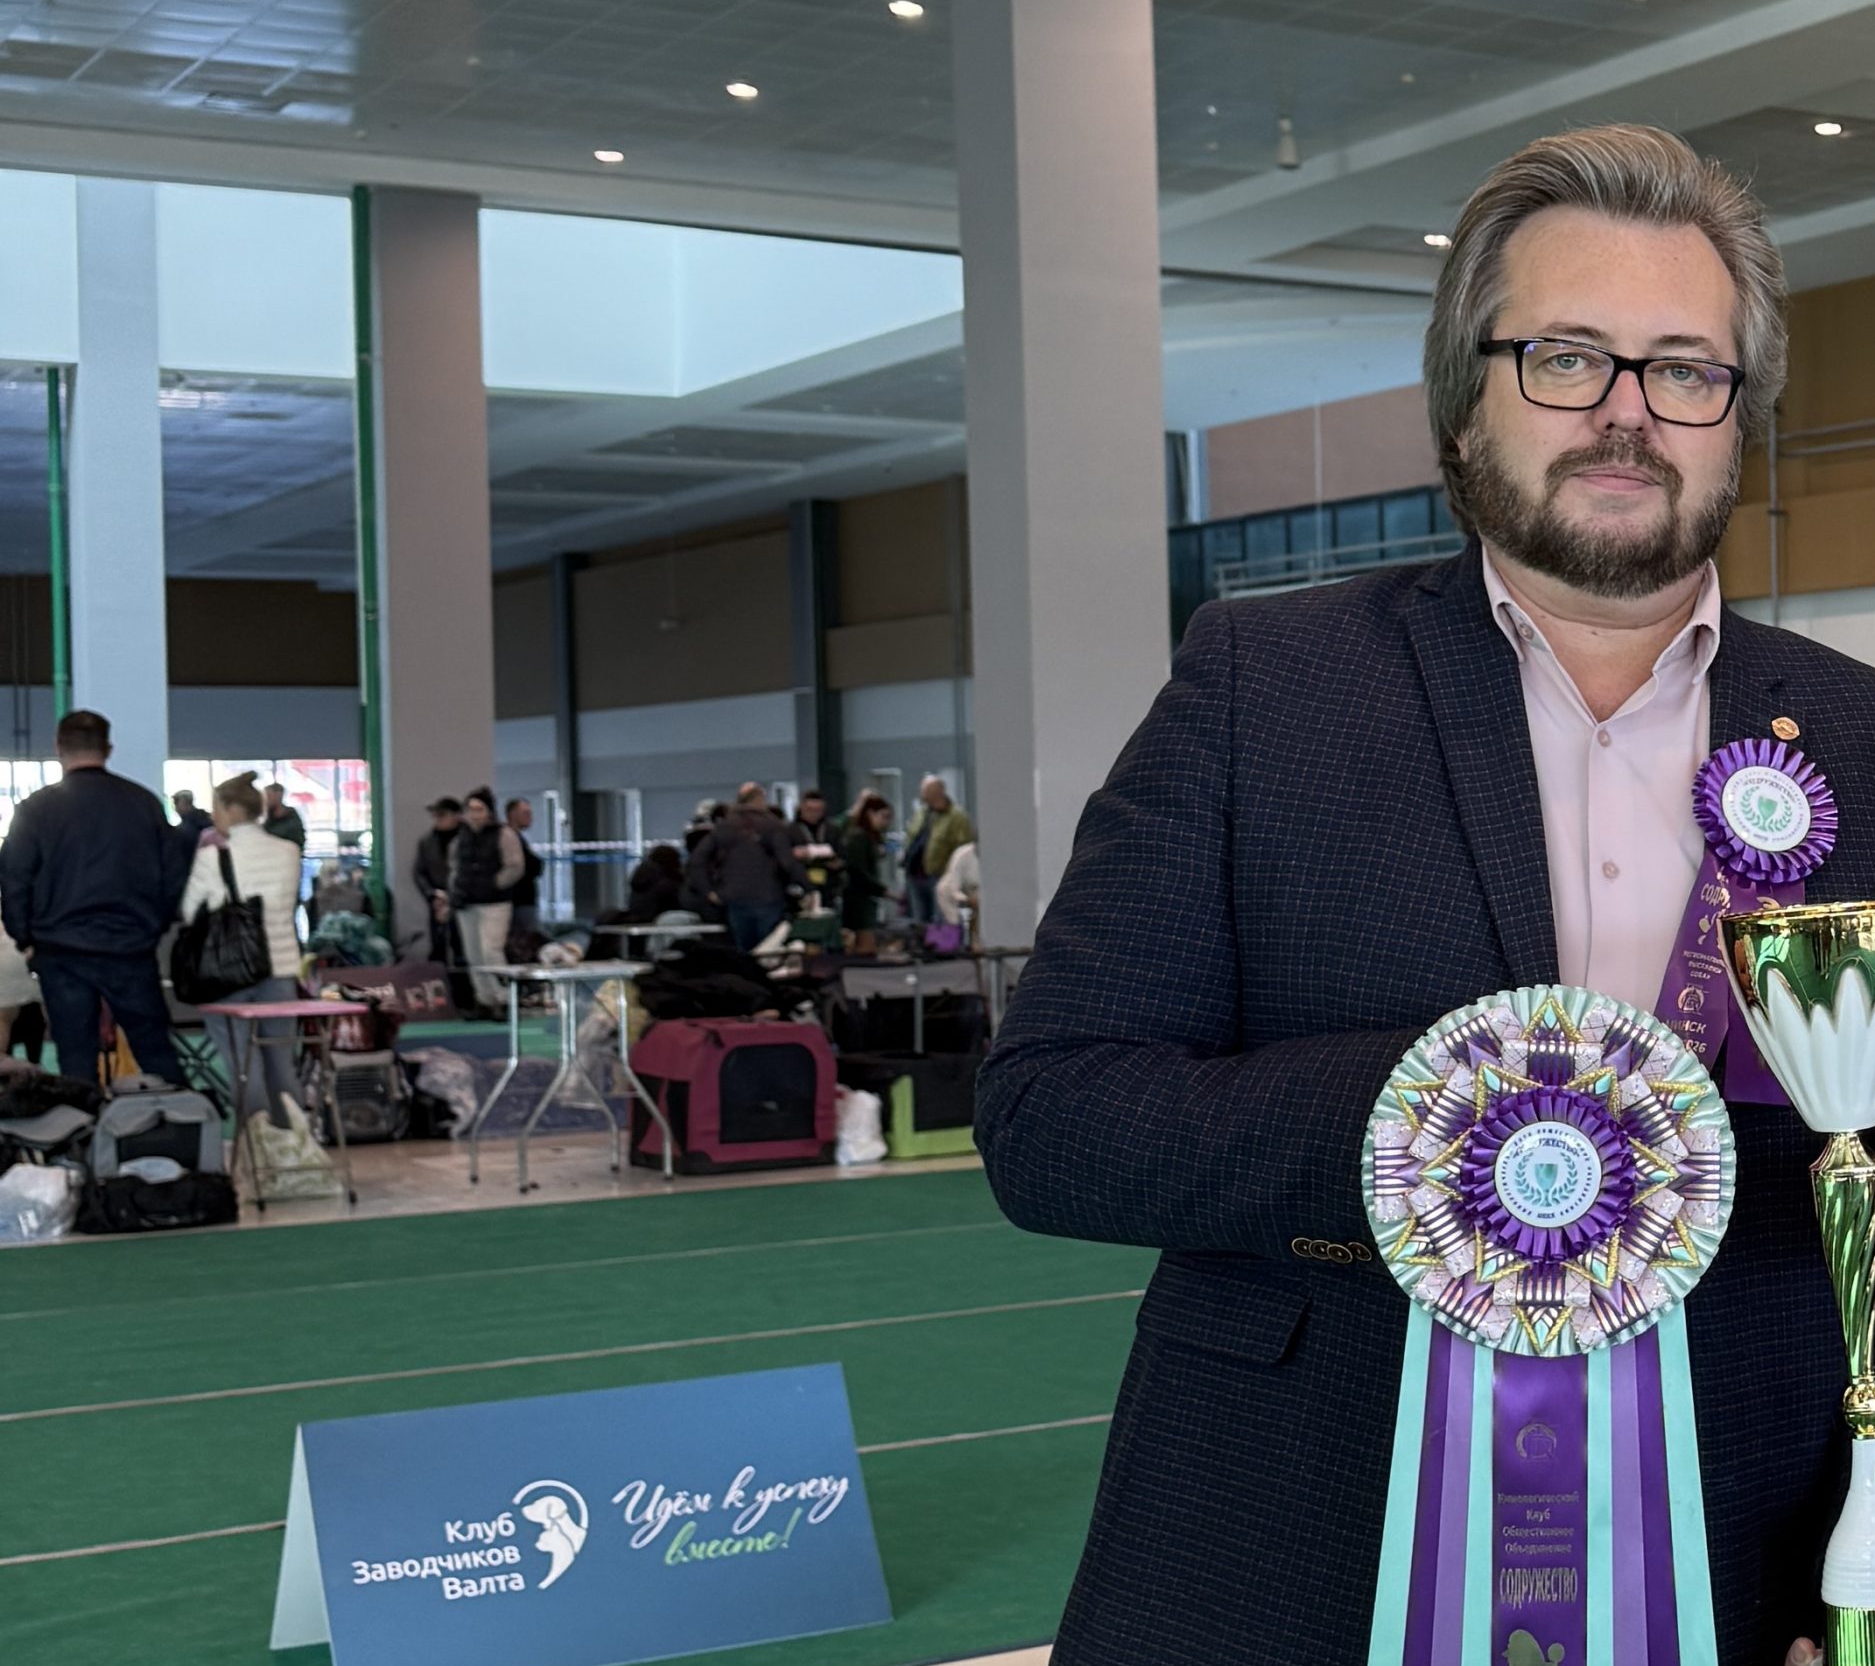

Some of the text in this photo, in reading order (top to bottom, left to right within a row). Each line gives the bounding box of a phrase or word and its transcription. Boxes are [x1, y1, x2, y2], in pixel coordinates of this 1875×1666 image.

[1684, 1039, 1708, 1053] 026
[732, 1476, 849, 1535] успеху
[444, 1511, 516, 1544] Клуб
[664, 1507, 803, 1566] вместе!
[351, 1545, 522, 1584] Заводчиков
[442, 1572, 526, 1600] Валта
[1500, 1567, 1579, 1610] СОДРУЖЕСТВО
